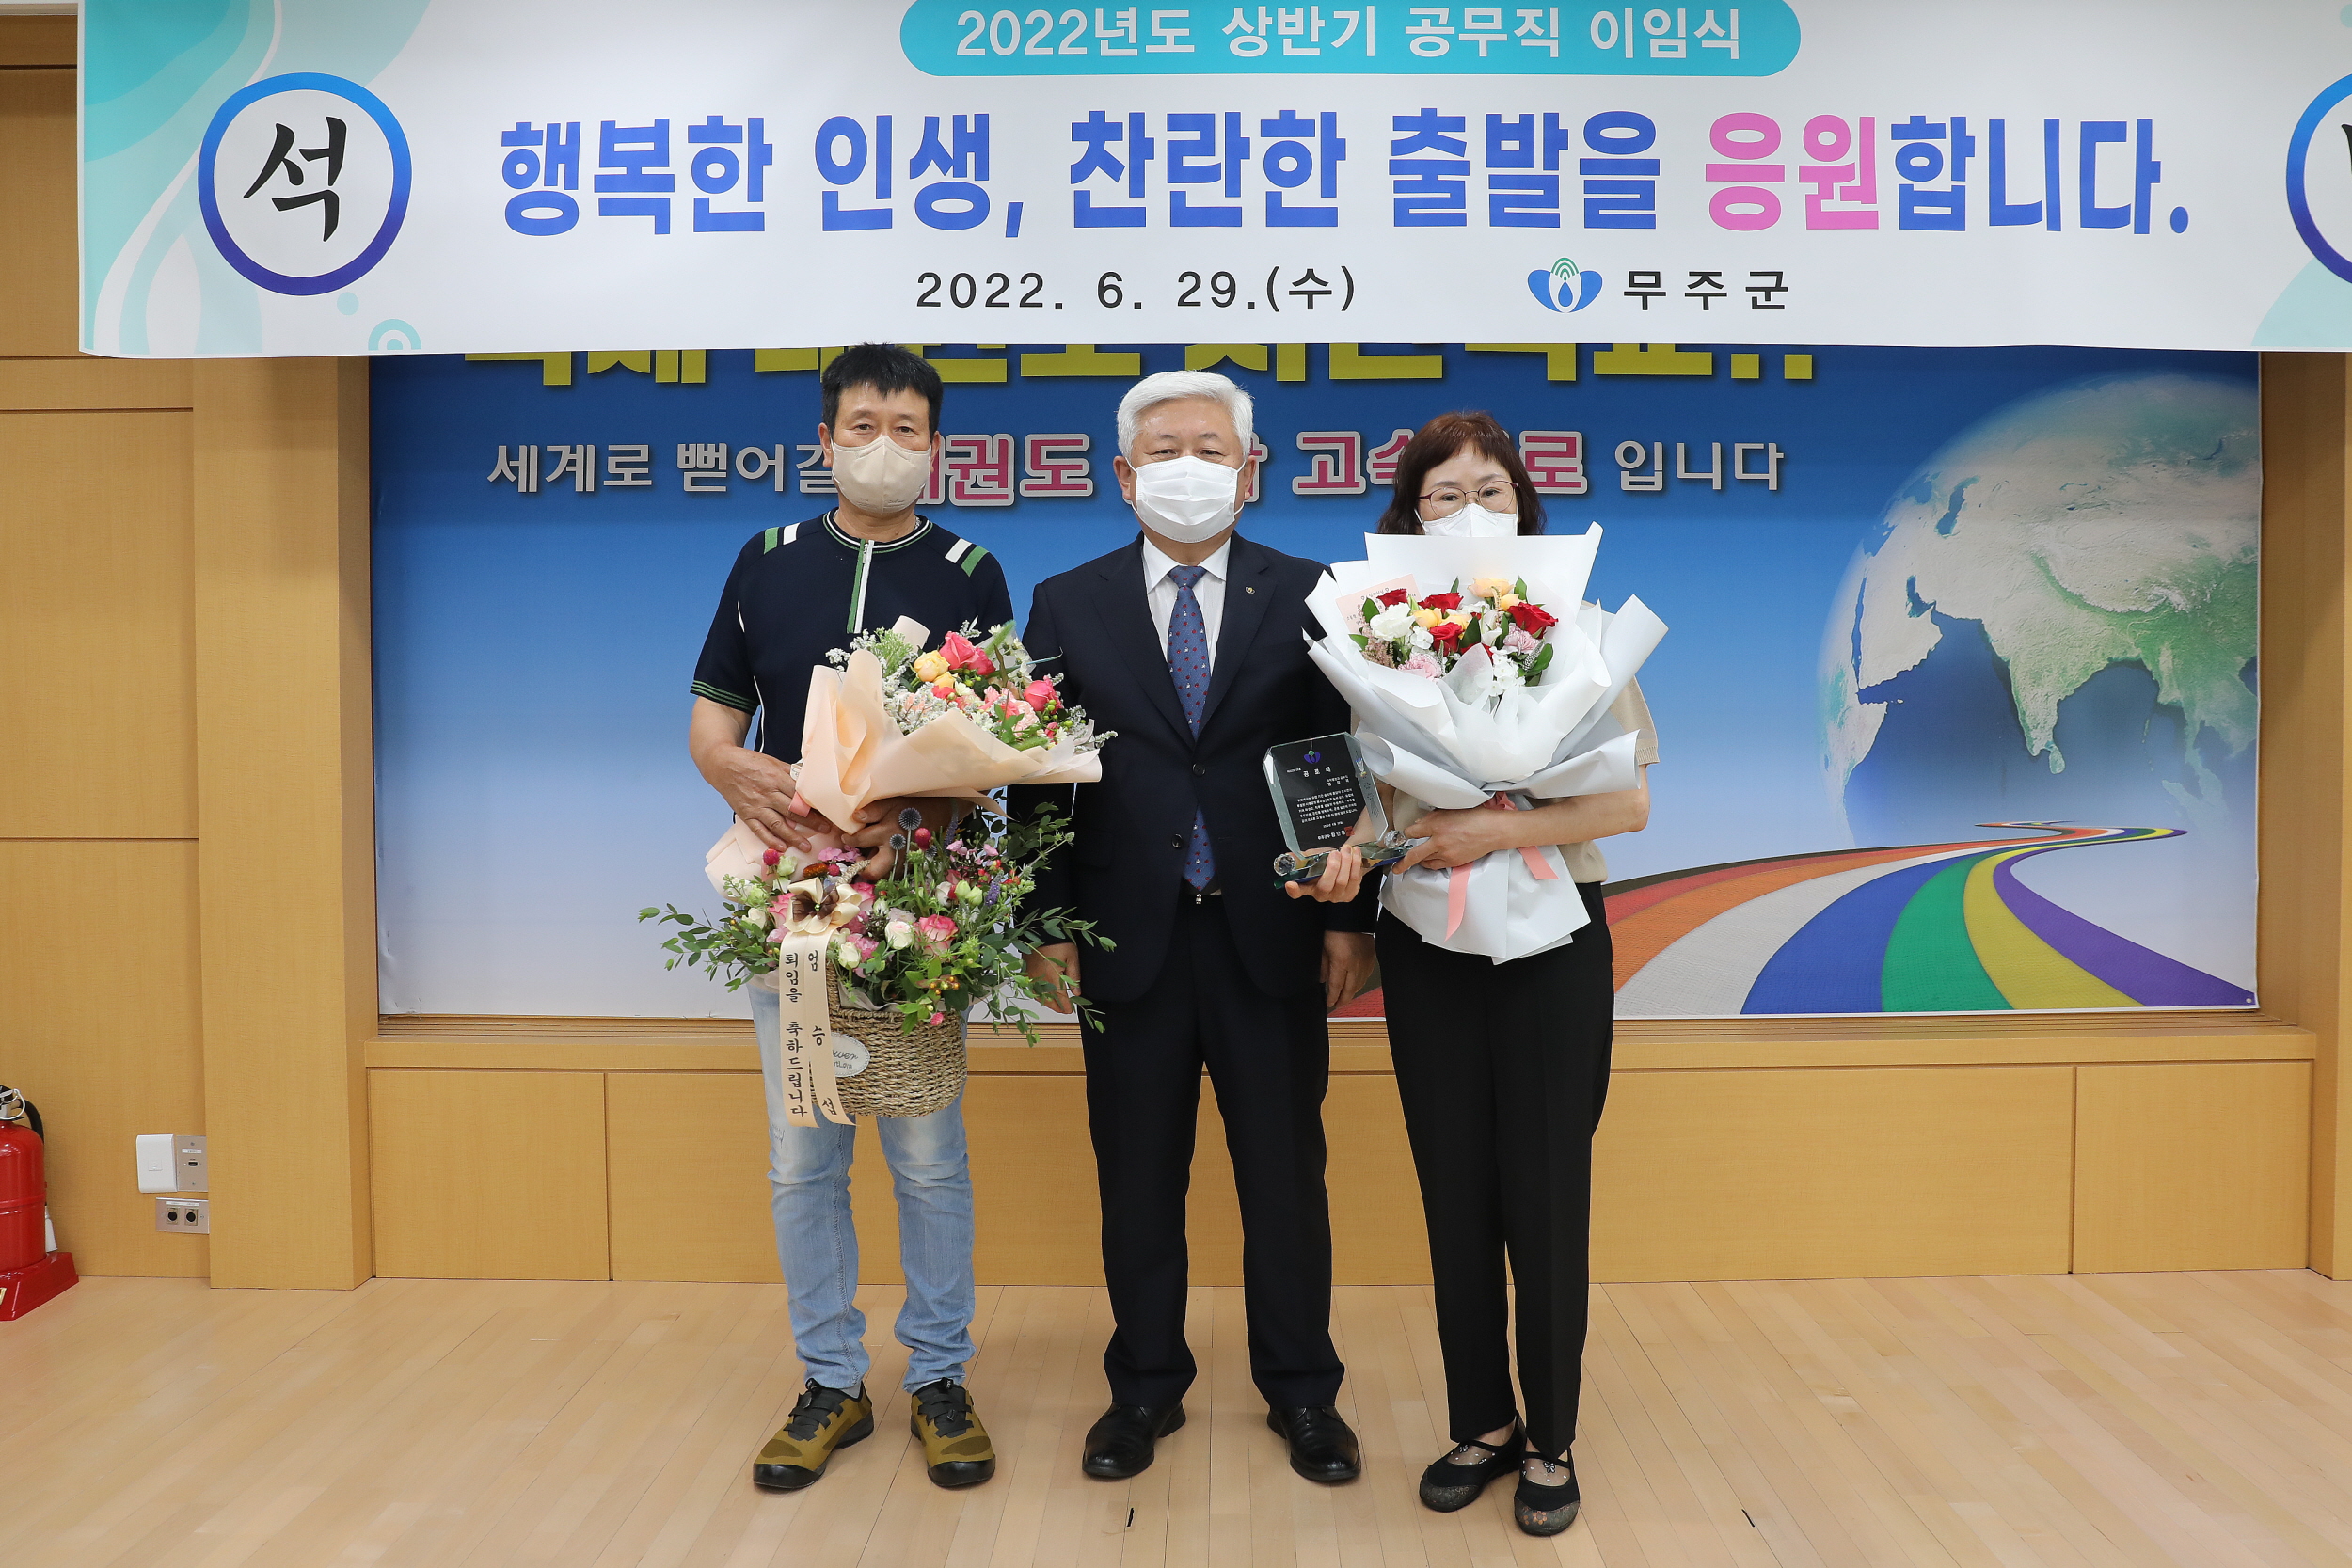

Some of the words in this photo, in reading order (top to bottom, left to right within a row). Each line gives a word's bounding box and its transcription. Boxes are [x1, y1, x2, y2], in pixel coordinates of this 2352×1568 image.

[956, 6, 1196, 57] 2022년도
[1221, 5, 1375, 57] 상반기
[1405, 7, 1559, 58] 공무직
[1590, 8, 1740, 60] 이임식
[243, 116, 347, 243] 석
[501, 115, 773, 236] 행복한
[815, 113, 1024, 238] 인생,
[1070, 109, 1346, 229] 찬란한
[1389, 108, 1661, 230] 출발을
[1706, 112, 2189, 235] 응원합니다.
[916, 272, 1063, 310] 2022.
[1097, 271, 1142, 310] 6.
[1177, 265, 1355, 312] 29.(수)
[1623, 270, 1788, 311] 무주군
[486, 444, 653, 493] 세계로
[1614, 440, 1785, 491] 입니다
[785, 952, 803, 1003] 퇴임을
[786, 1022, 808, 1117] 축하드립니다
